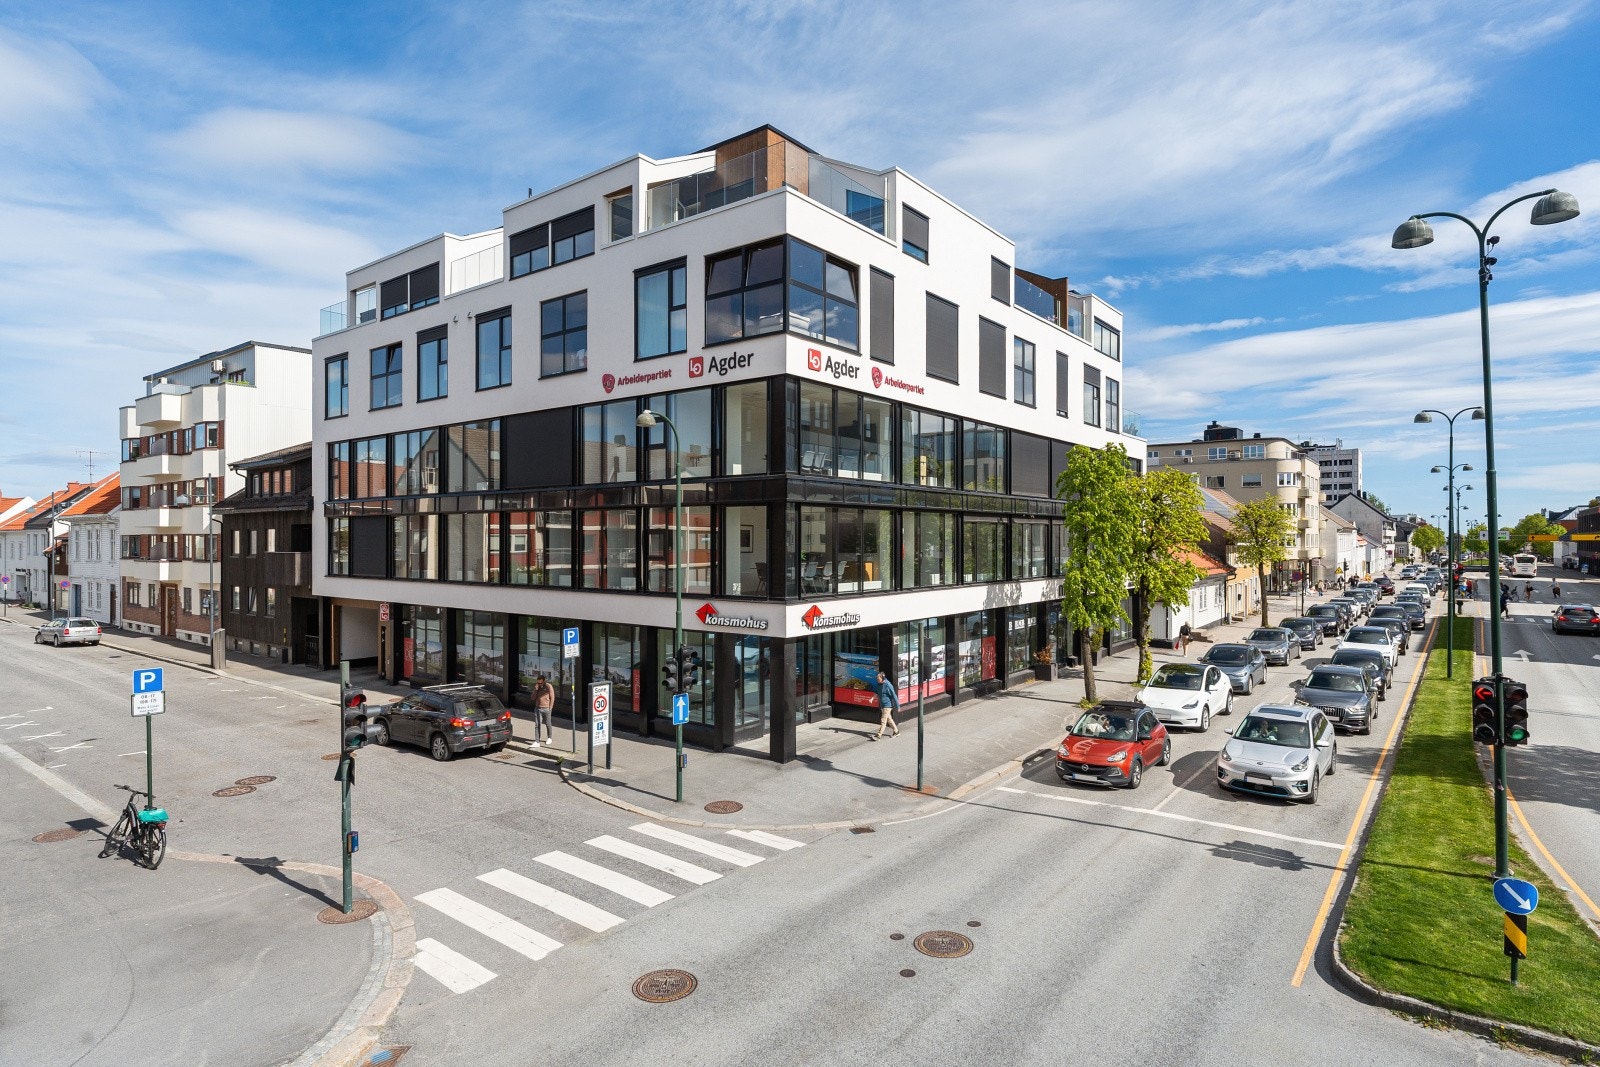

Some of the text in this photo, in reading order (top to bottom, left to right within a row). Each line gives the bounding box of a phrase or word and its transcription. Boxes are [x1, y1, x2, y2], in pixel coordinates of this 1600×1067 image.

[708, 351, 754, 376] Agder
[824, 356, 860, 379] Agder
[617, 368, 672, 386] Arbeiderpartiet
[884, 376, 925, 395] Arbeiderpartiet
[705, 613, 768, 630] konsmohus
[567, 630, 576, 643] P
[140, 672, 156, 690] P
[596, 699, 605, 709] 30
